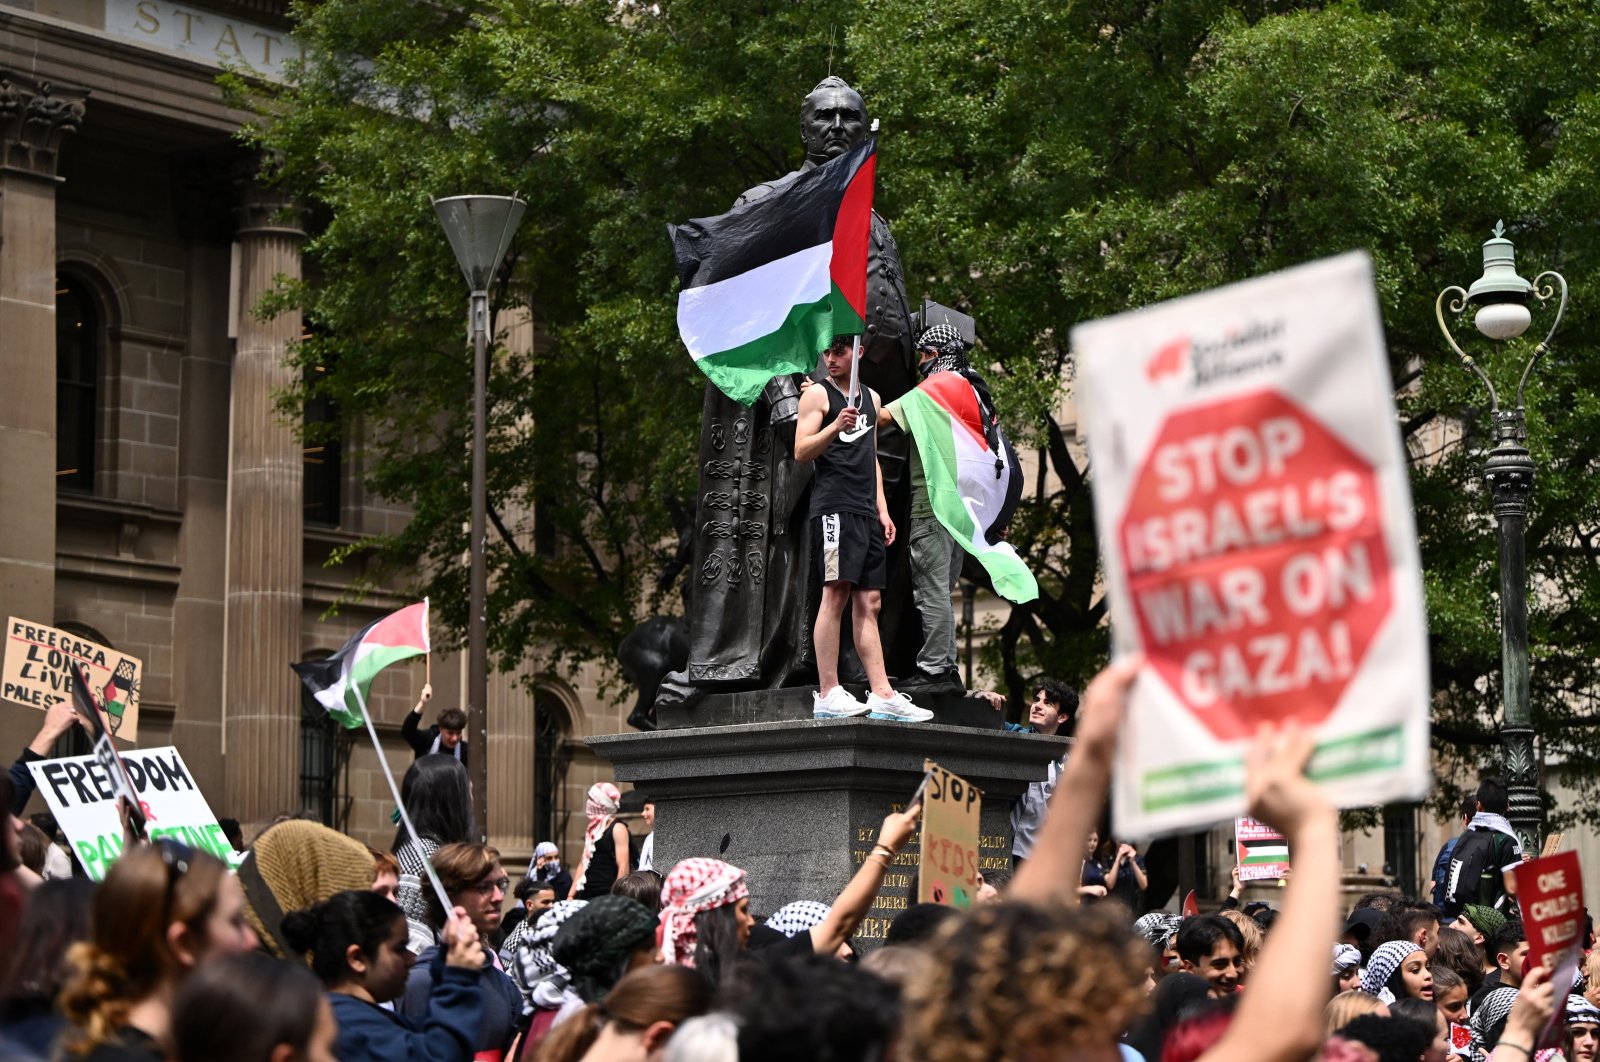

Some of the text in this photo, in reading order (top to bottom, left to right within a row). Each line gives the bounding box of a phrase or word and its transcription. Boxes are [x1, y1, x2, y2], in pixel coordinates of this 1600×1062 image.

[133, 1, 306, 74] STAT
[1154, 416, 1304, 501] STOP
[1125, 470, 1365, 571] ISRAEL'S
[1139, 541, 1374, 646] WAR ON
[13, 622, 106, 667] FREE GAZA
[1181, 621, 1355, 708] GAZA!
[42, 754, 194, 808] FREDOM
[930, 767, 977, 813] STOP
[927, 833, 976, 886] KIDS
[1537, 869, 1567, 893] ONE
